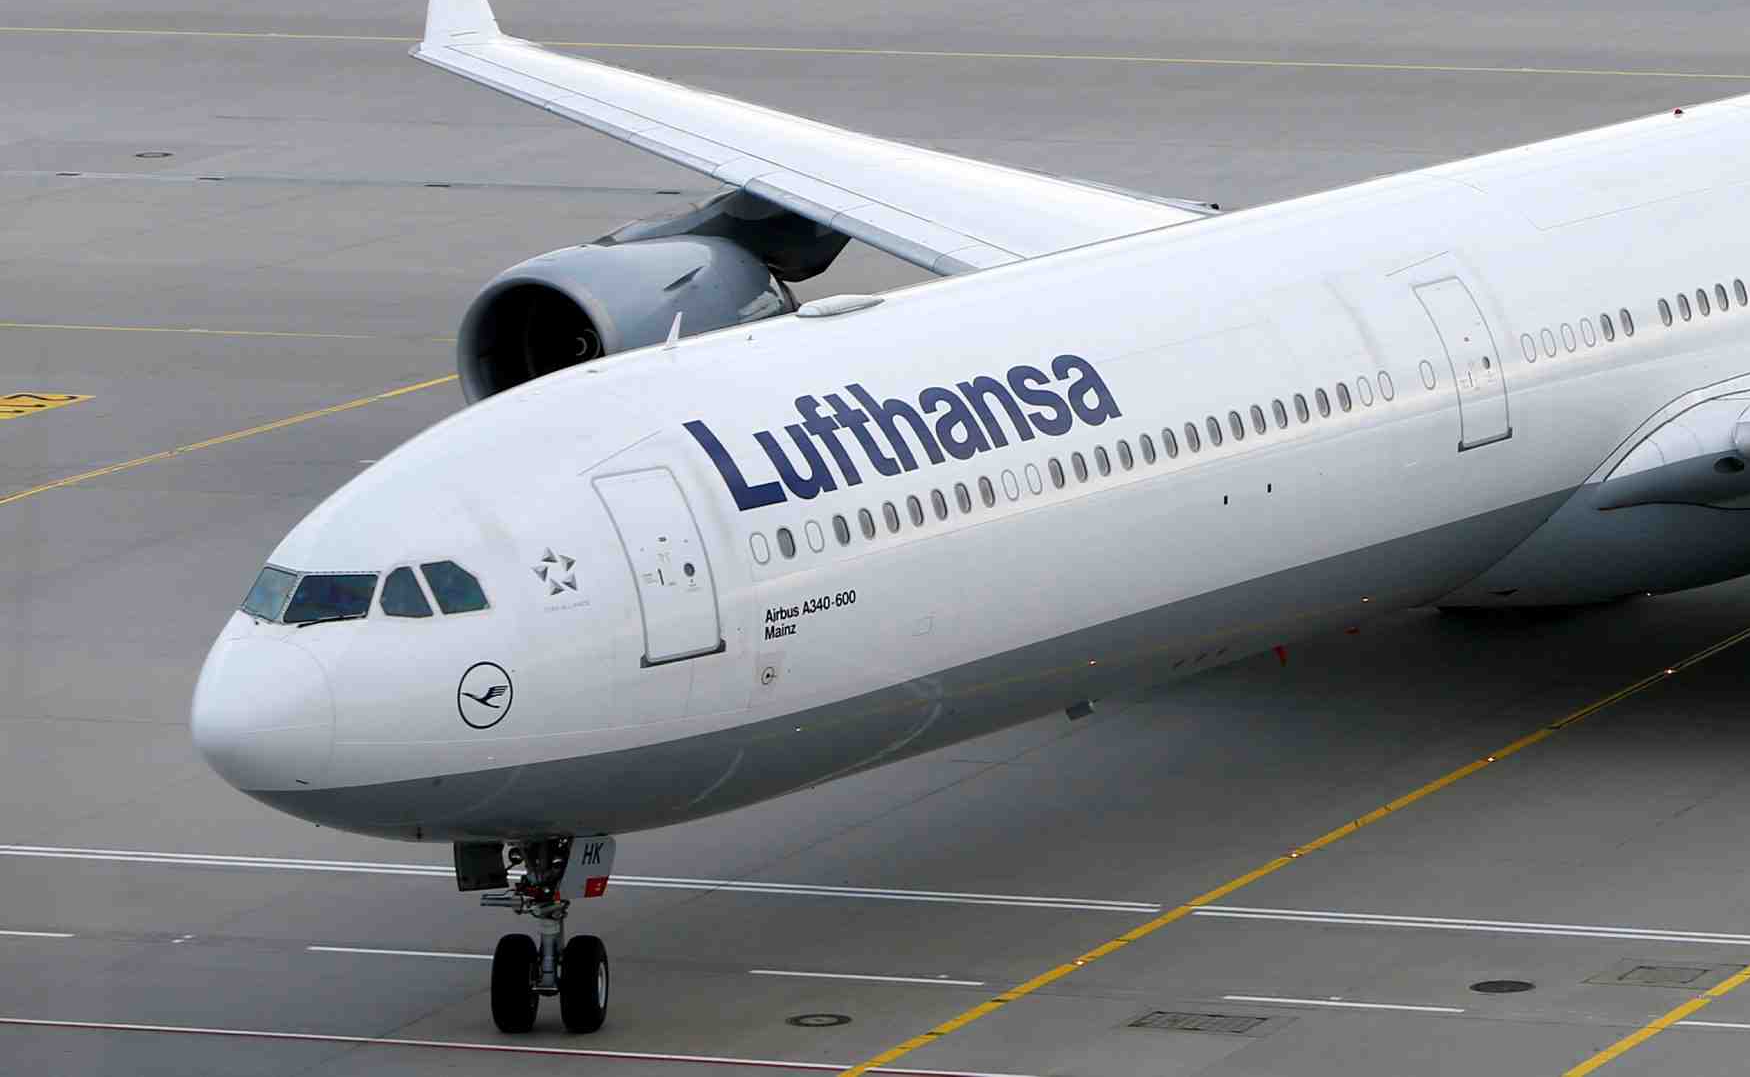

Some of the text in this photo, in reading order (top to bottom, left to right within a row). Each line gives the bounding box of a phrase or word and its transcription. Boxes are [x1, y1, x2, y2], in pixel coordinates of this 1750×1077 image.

[682, 354, 1123, 511] Lufthansa
[765, 589, 857, 624] Airbus A340-600
[764, 623, 797, 641] Mainz
[582, 842, 604, 866] HK
